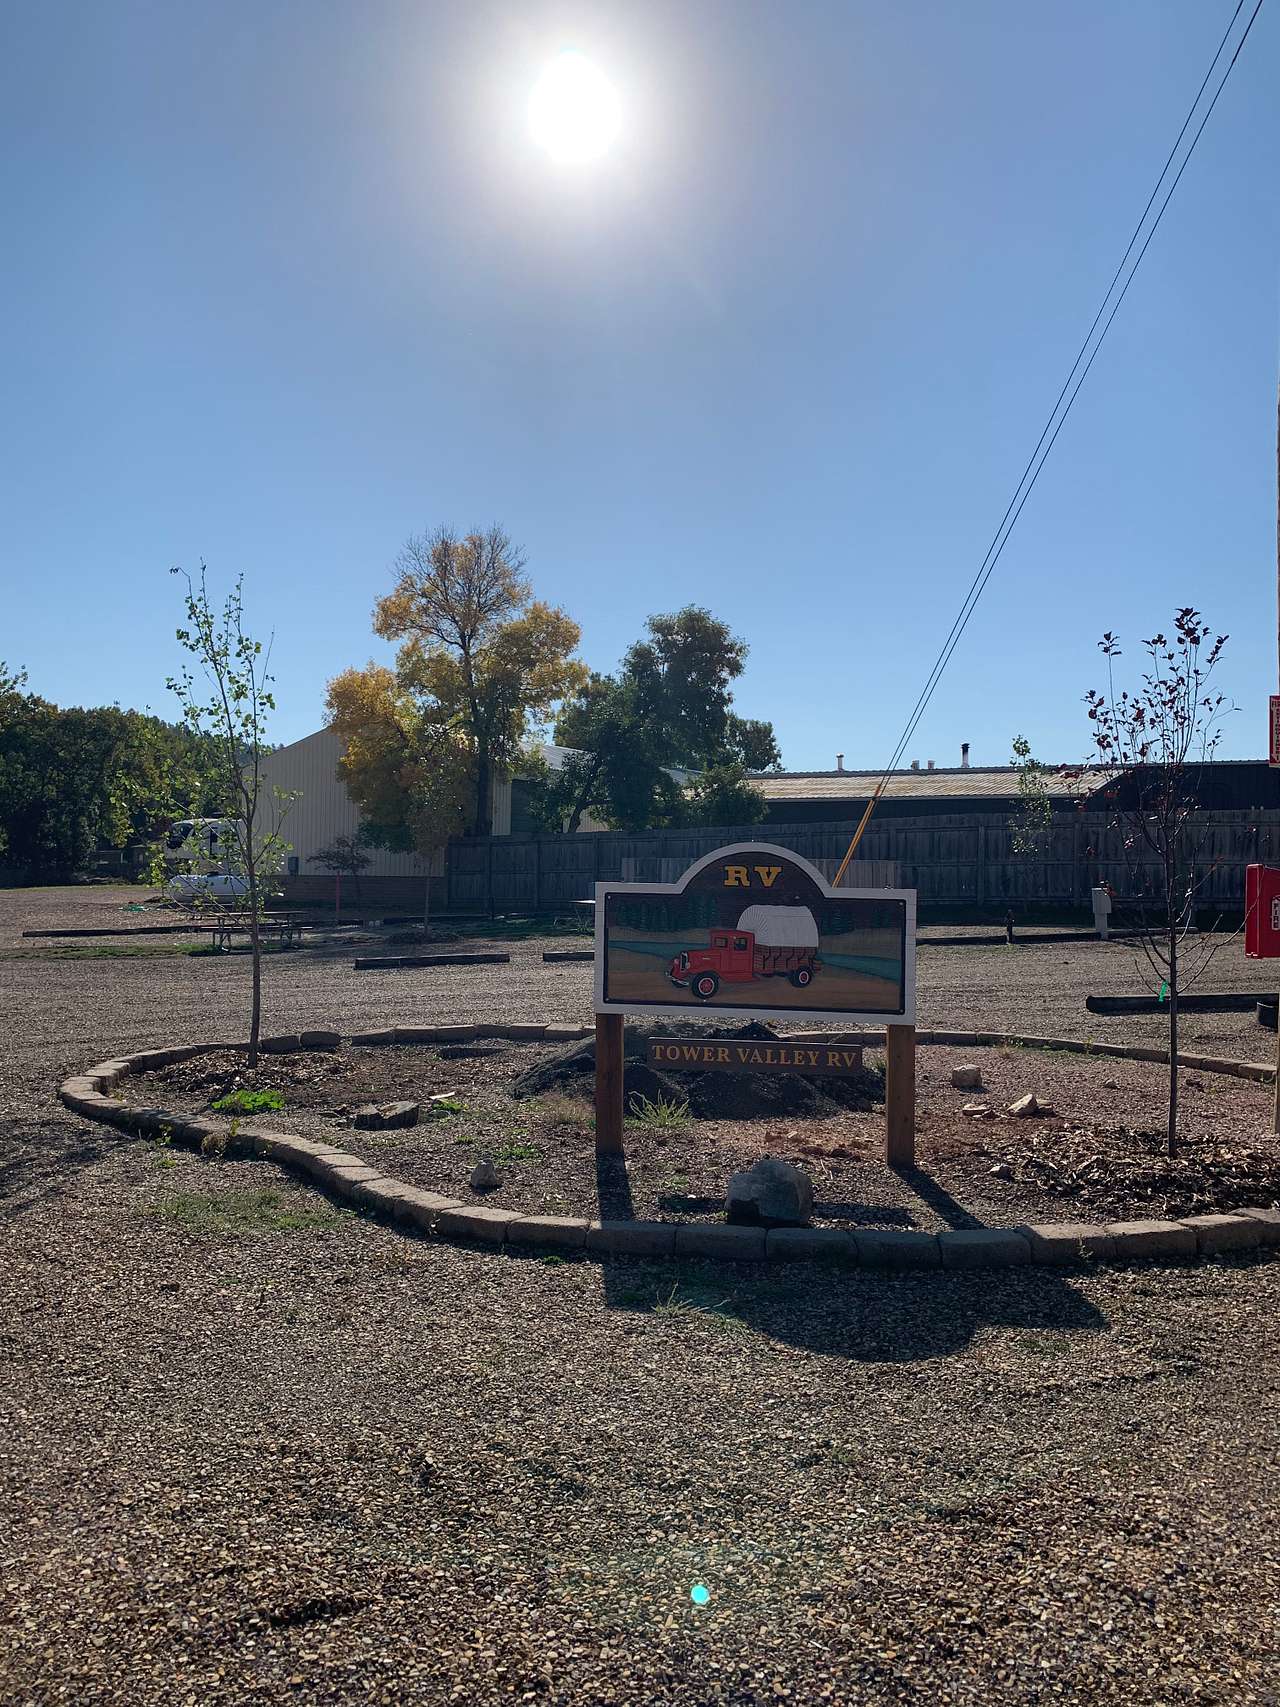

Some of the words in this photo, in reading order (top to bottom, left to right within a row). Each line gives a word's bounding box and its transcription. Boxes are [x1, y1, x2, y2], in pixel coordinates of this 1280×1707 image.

[724, 865, 783, 887] RV
[652, 1045, 731, 1063] TOWER
[735, 1048, 820, 1066] VALLEY
[826, 1051, 857, 1068] RV
